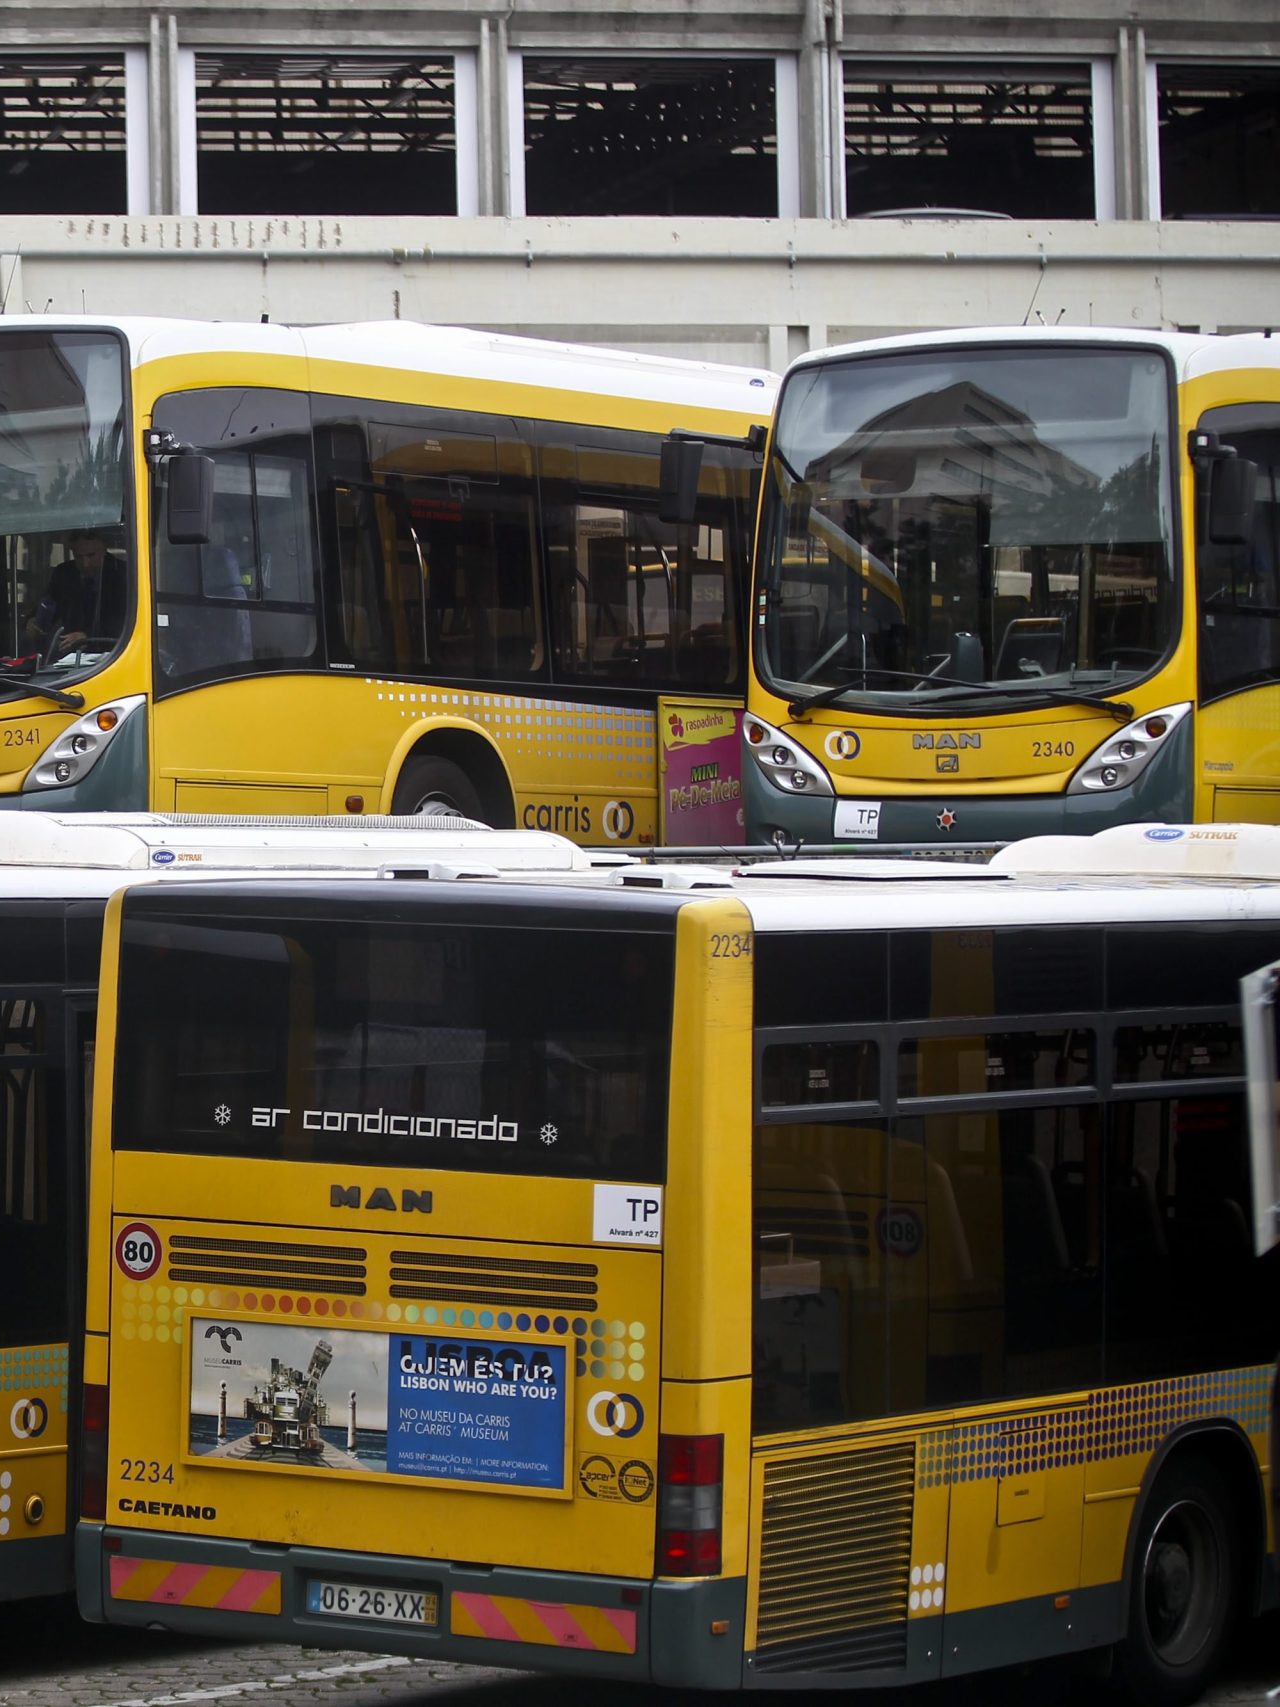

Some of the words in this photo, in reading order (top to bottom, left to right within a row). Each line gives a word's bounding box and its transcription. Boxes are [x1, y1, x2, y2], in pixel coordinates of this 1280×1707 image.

[686, 713, 724, 731] raspadinha
[4, 728, 41, 747] 2341
[912, 733, 982, 750] MAN
[1032, 741, 1075, 758] 2340
[691, 762, 720, 783] MINI
[523, 795, 591, 833] carris
[857, 809, 878, 825] TP
[1147, 829, 1182, 840] Carrier
[1189, 831, 1238, 840] SUTRAK
[711, 934, 752, 958] 2234
[252, 1107, 291, 1128] ar
[303, 1107, 519, 1142] condicionado
[330, 1184, 433, 1214] MAN
[626, 1198, 659, 1222] TP
[609, 1228, 633, 1237] Alvará
[124, 1240, 154, 1263] 80
[400, 1355, 468, 1377] QUEM
[474, 1355, 503, 1379] ÉS
[513, 1363, 553, 1384] TU?
[400, 1376, 449, 1391] LISBON
[453, 1379, 488, 1395] WHO
[491, 1383, 517, 1397] ARE
[520, 1386, 557, 1400] YOU?
[399, 1407, 418, 1420] NO
[420, 1410, 456, 1424] MUSEU
[458, 1412, 473, 1425] DA
[475, 1414, 511, 1428] CARRIS
[398, 1422, 412, 1433] AT
[460, 1427, 510, 1442] MUSEUM
[398, 1451, 414, 1460] MAIS
[480, 1459, 500, 1468] MORE
[120, 1459, 175, 1485] 2234
[118, 1498, 217, 1521] CAETANO
